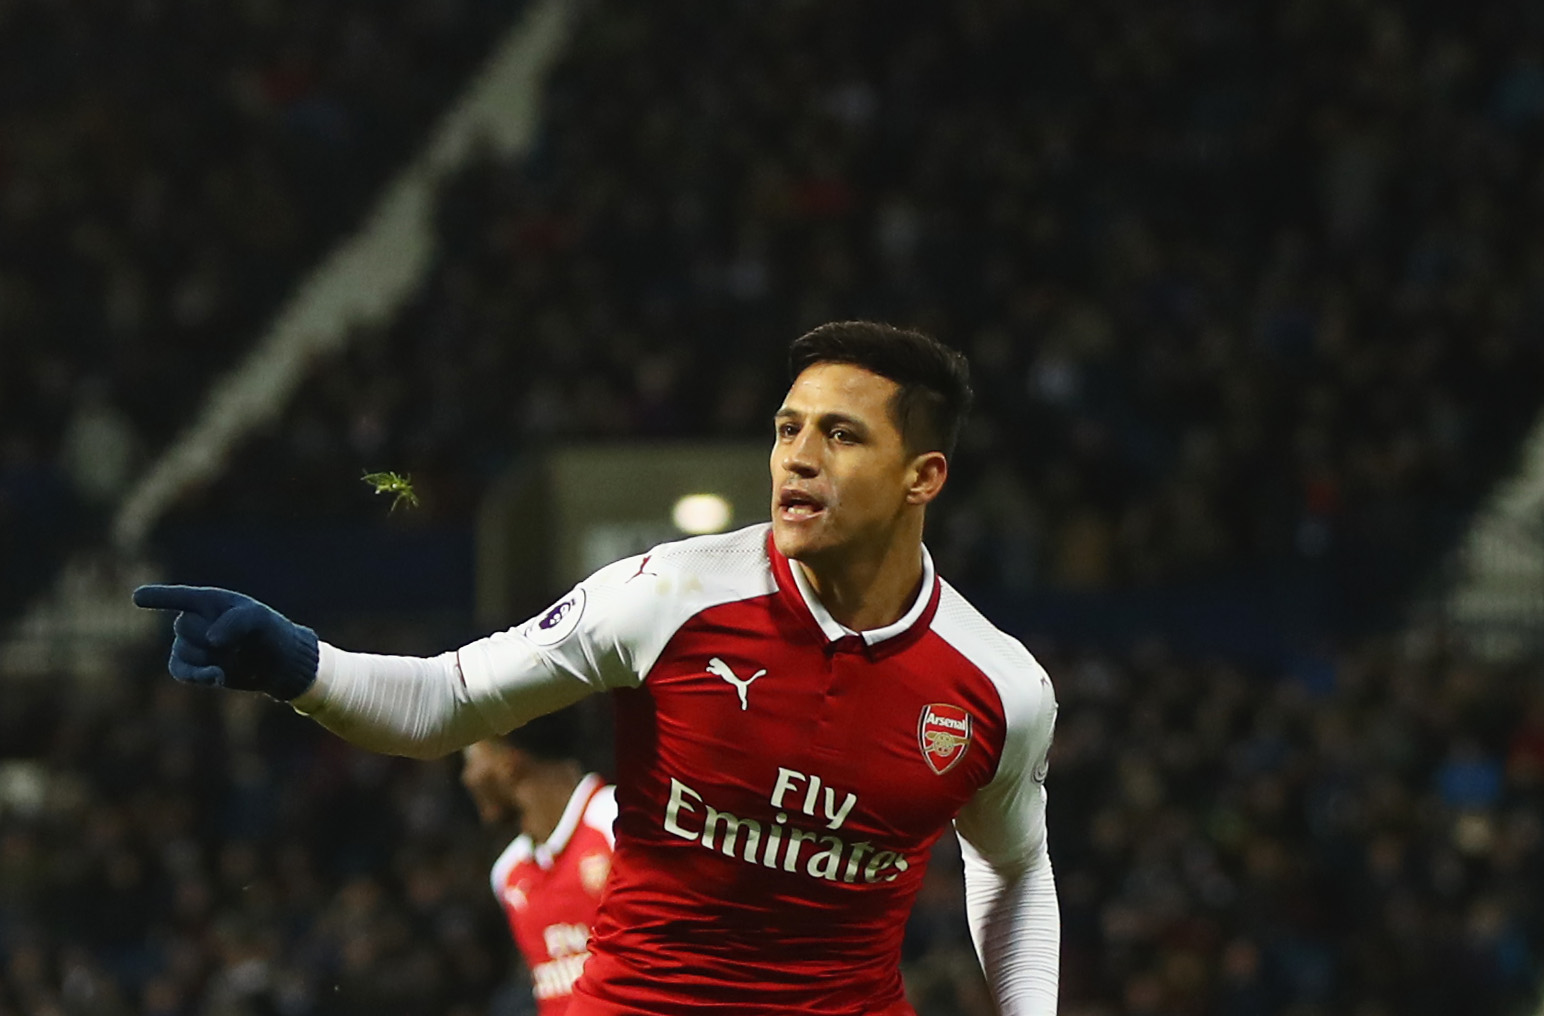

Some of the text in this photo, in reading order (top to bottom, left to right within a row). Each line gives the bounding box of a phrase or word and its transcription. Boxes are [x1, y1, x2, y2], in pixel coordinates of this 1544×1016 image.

[927, 712, 966, 731] Arsenal
[663, 777, 909, 883] Emirates
[770, 766, 857, 830] Fly
